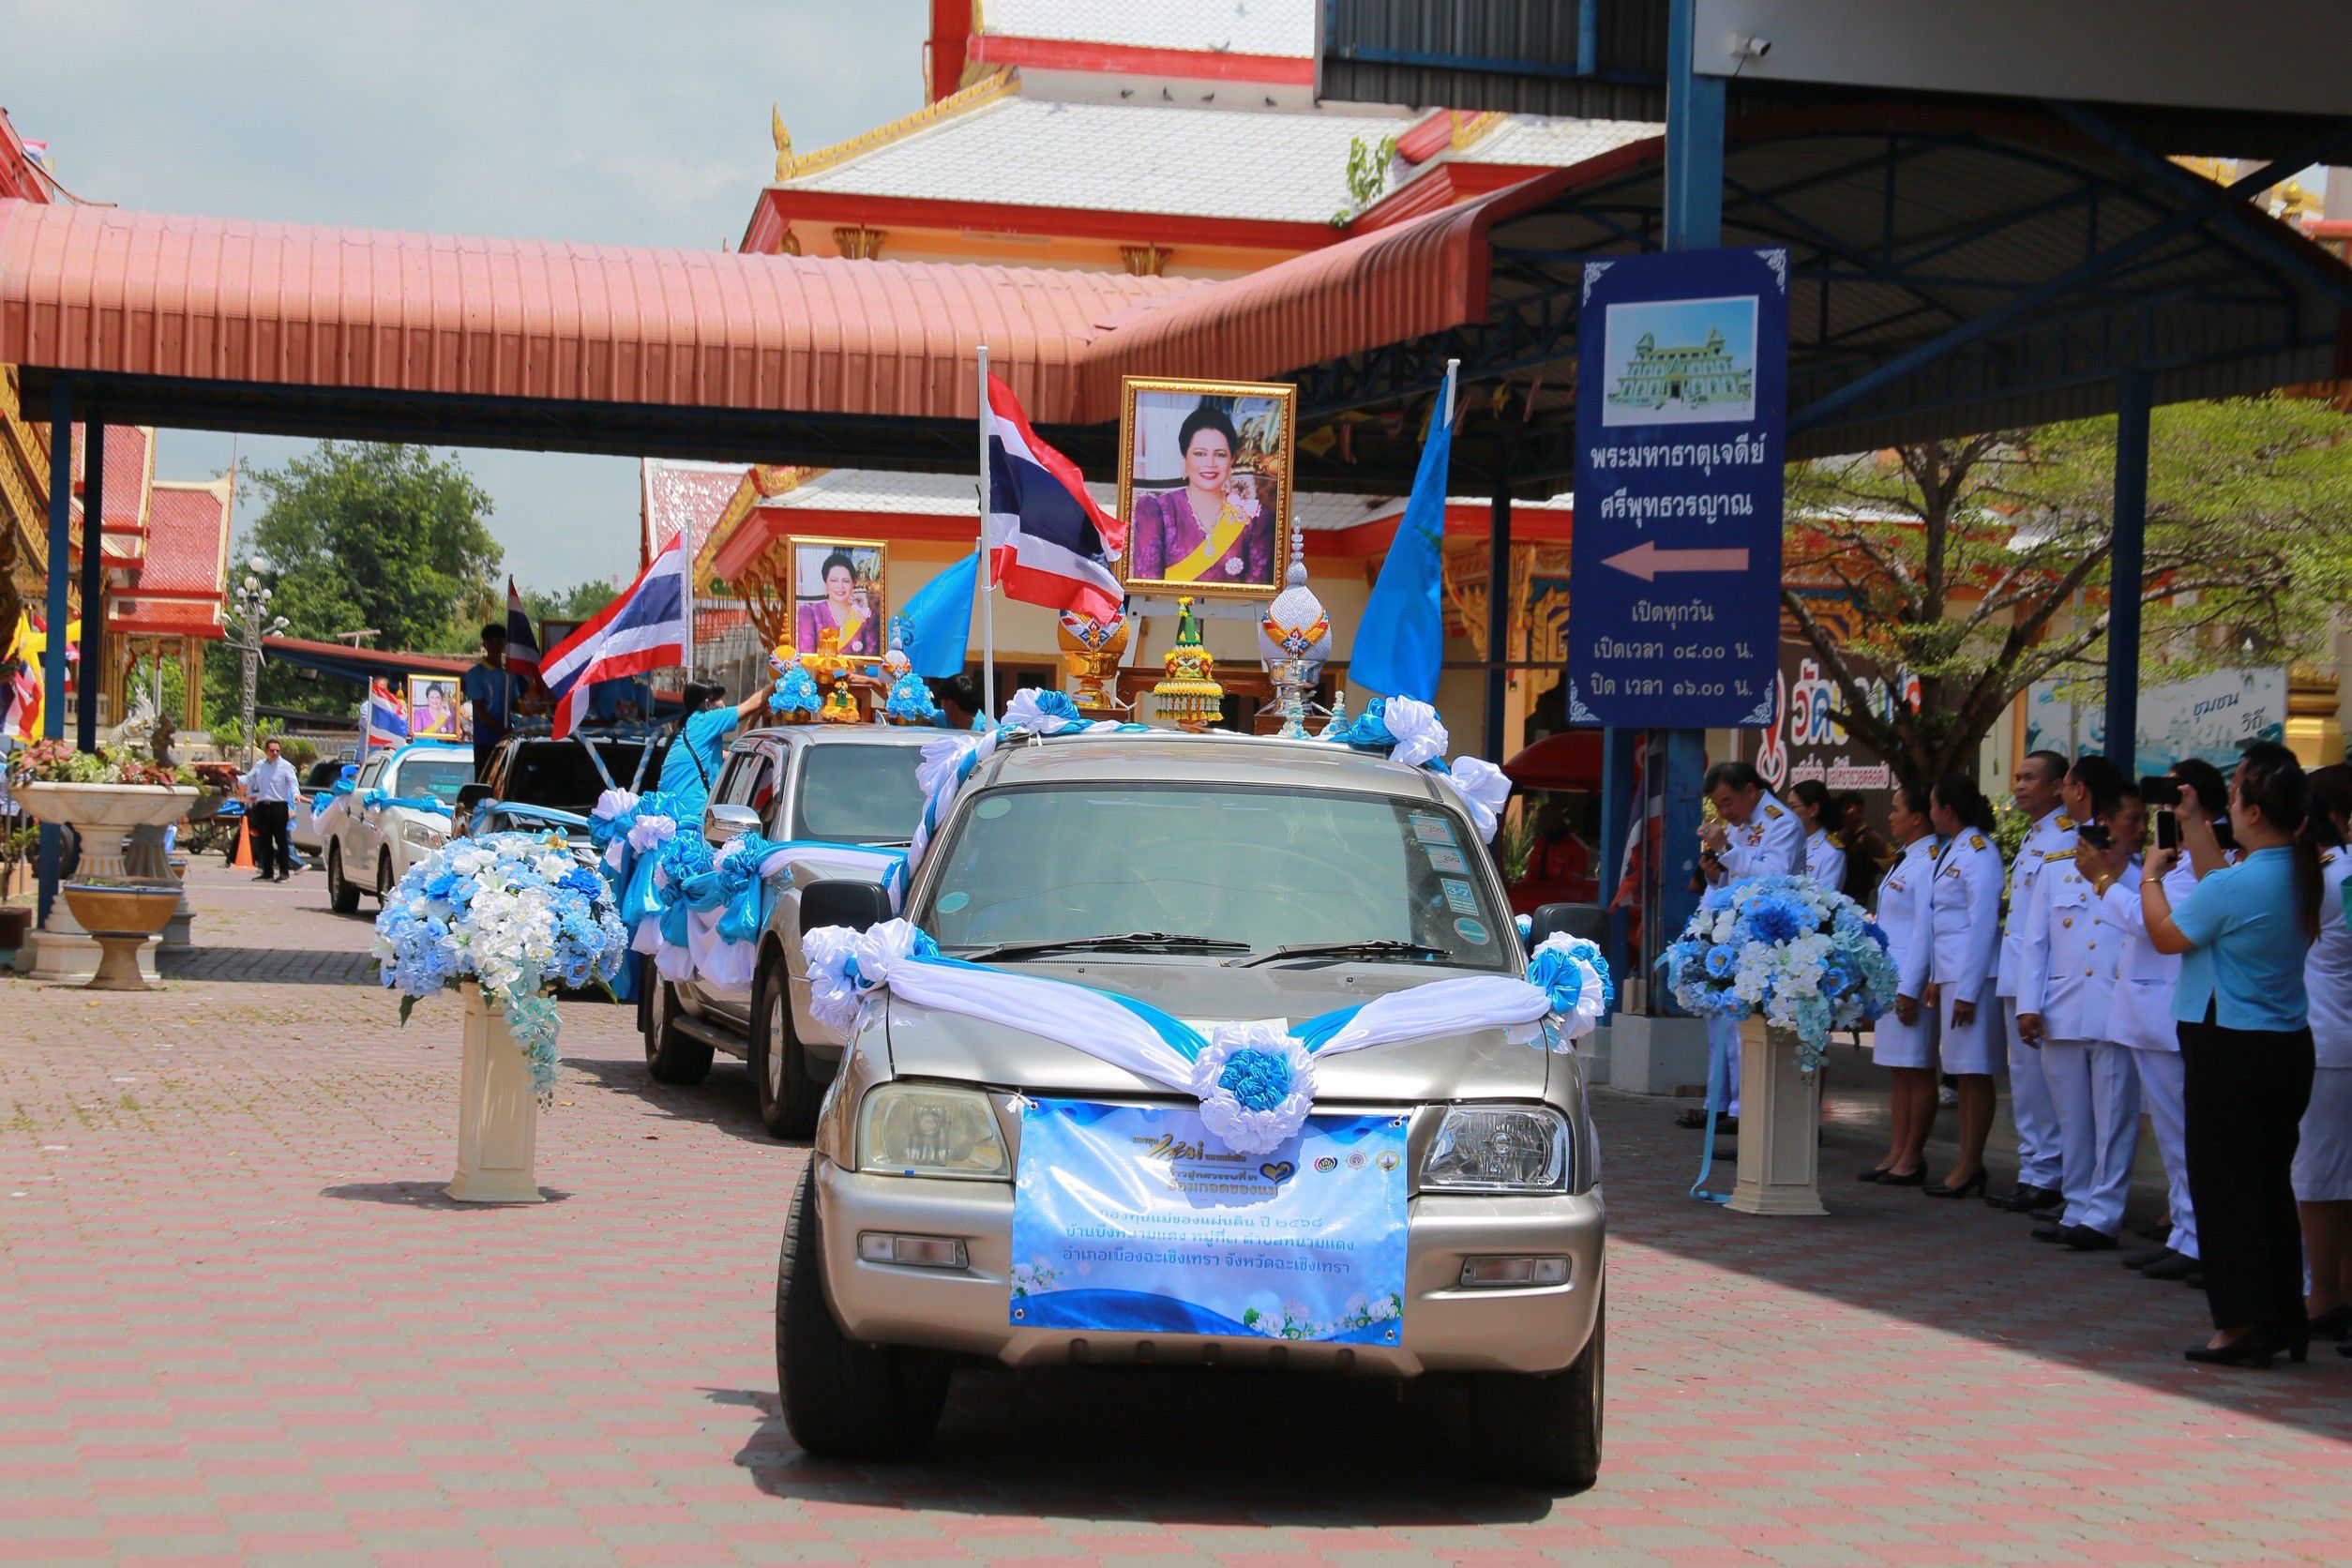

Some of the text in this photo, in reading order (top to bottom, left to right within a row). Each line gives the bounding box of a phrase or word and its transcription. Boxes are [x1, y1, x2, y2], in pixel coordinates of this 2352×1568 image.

[1591, 432, 1768, 476] พระมหาธาตุเจดีย์
[1601, 487, 1754, 529] ศรีพุทธวรญาณ
[1632, 598, 1715, 630] เปิดทุกวัน
[1594, 636, 1754, 658] เปิดเวลา ๐๘.๐๐ น.
[1591, 672, 1754, 695] ปิด เวลา ๑๖.๐๐ น.
[2194, 692, 2240, 725] ชุมชน
